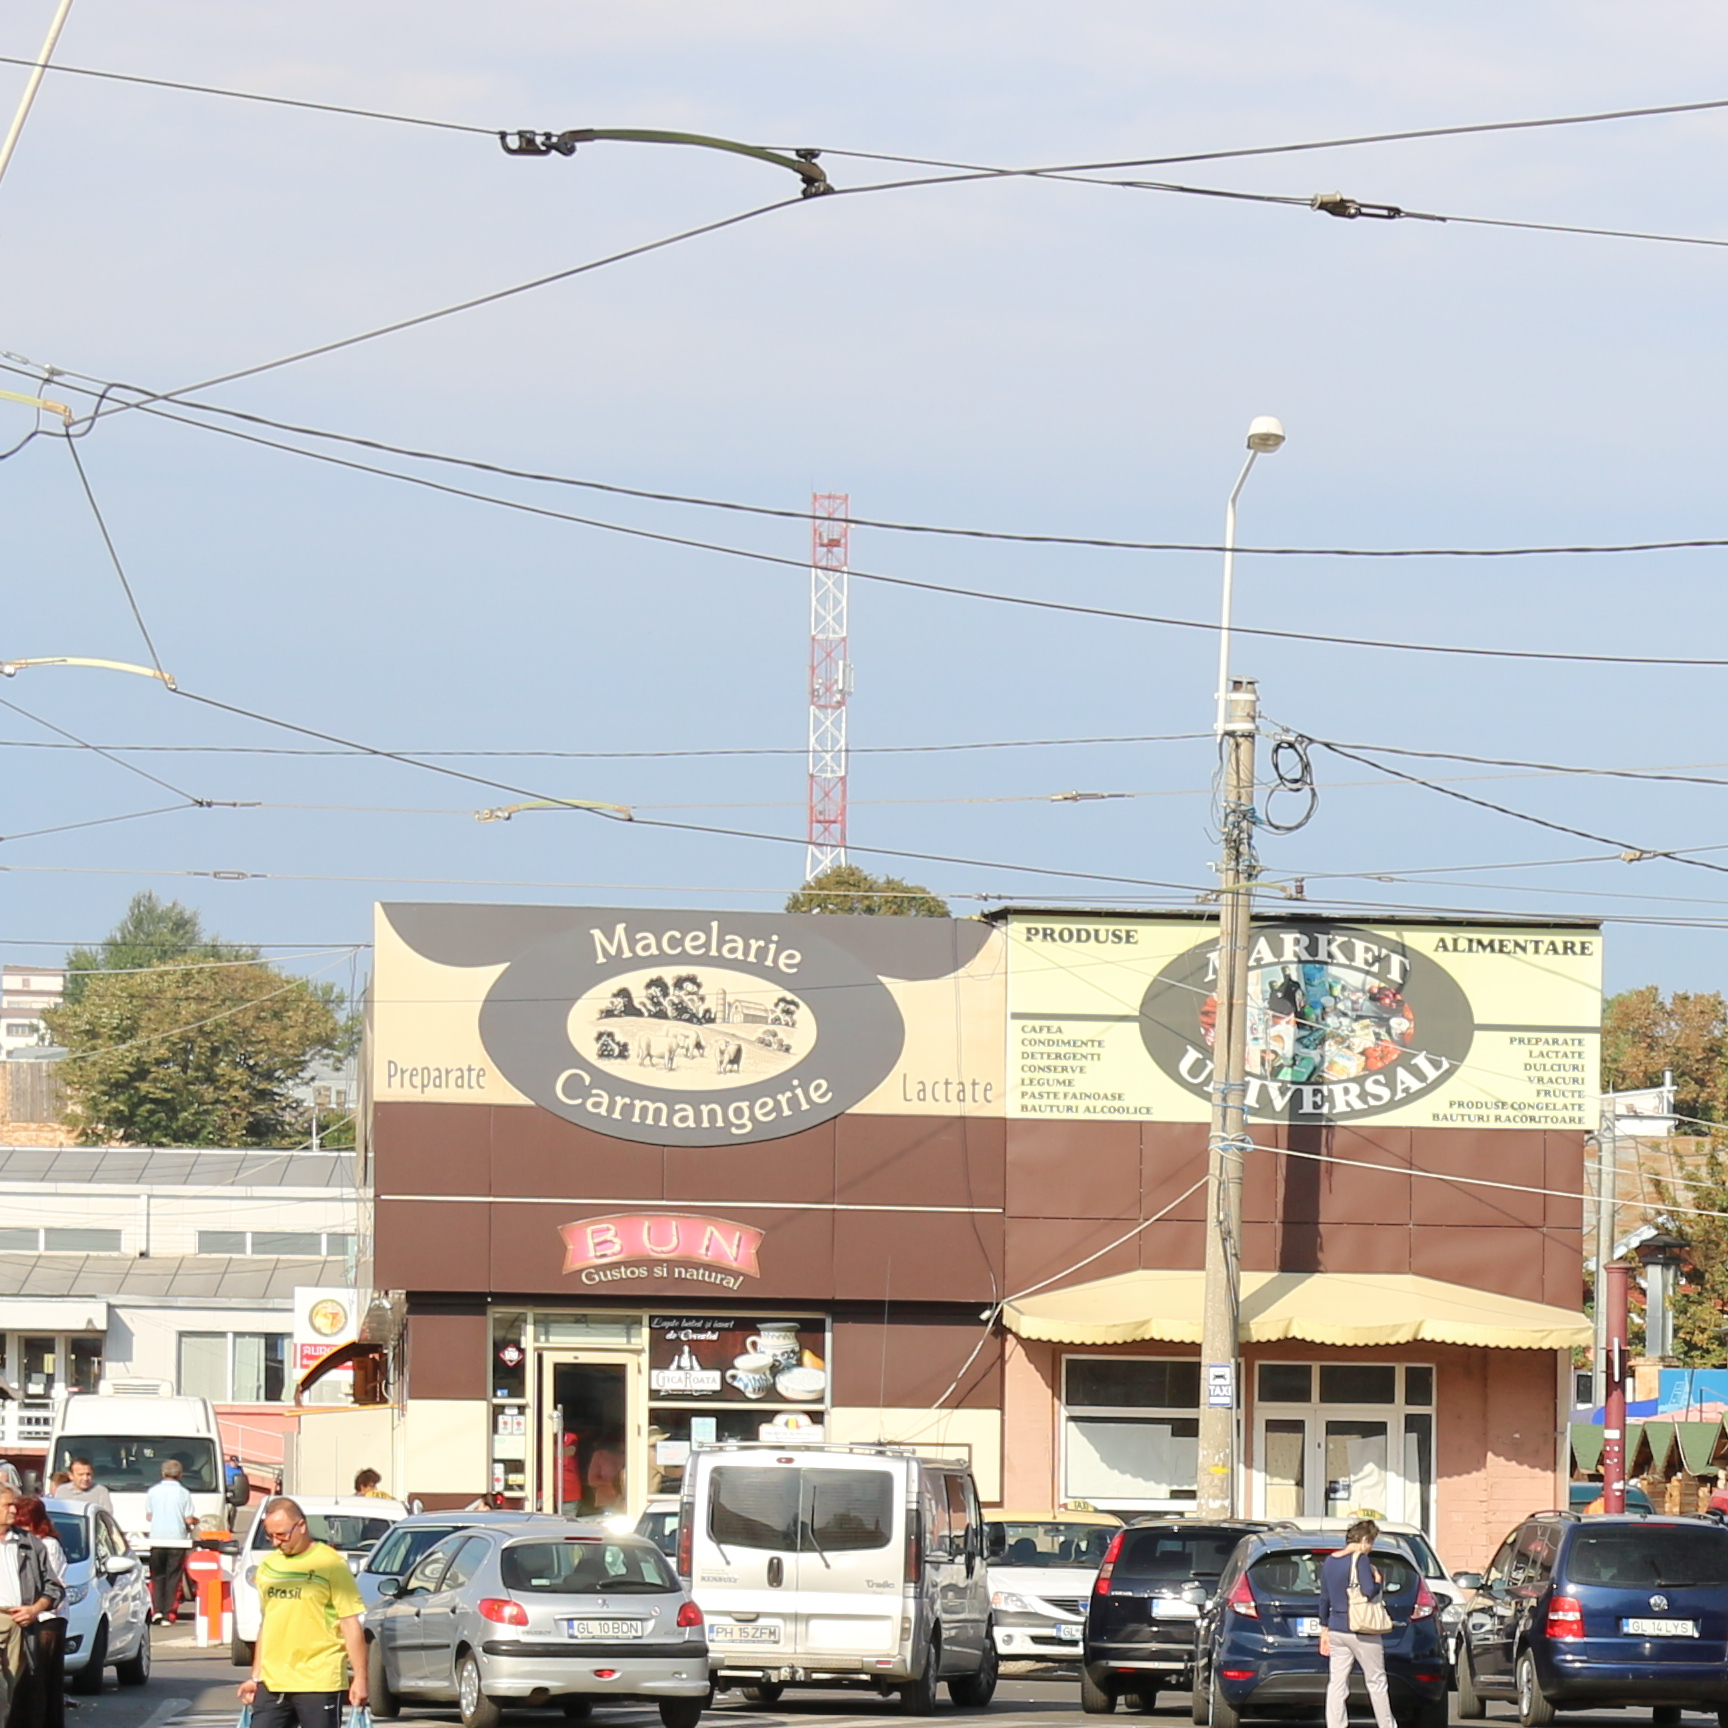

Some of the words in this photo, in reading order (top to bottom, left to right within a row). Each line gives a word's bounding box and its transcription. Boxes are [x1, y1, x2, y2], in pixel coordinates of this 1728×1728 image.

[1025, 925, 1139, 946] PRODUSE
[589, 921, 803, 976] Macelarie
[1433, 936, 1594, 957] ALIMENTARE
[1020, 1024, 1063, 1034] CAFEA
[1020, 1038, 1105, 1048] CONDIMENTE
[1509, 1036, 1586, 1047] PREPARATE
[1020, 1051, 1102, 1061] DETERGENTI
[1528, 1050, 1586, 1060] LACTATE
[1020, 1064, 1087, 1074] CONSERVE
[1523, 1062, 1586, 1072] DULCIURI
[386, 1059, 488, 1094] Preparate
[1020, 1077, 1075, 1087] LEGUME
[1177, 1045, 1452, 1115] UIVERSAL
[1527, 1076, 1586, 1086] VRACURI
[902, 1072, 994, 1104] Lactate
[1536, 1089, 1586, 1099] FRUCTE
[554, 1067, 834, 1135] Carmangerie
[1020, 1090, 1060, 1100] PASTE
[1063, 1092, 1125, 1101] FAINOASE
[1020, 1103, 1079, 1114] BAUTURI
[1083, 1105, 1154, 1115] ALCOOLICE
[1448, 1100, 1508, 1111] PRODUSE
[1510, 1101, 1586, 1112] CONGELATE
[1432, 1112, 1490, 1123] BAUTURI
[1494, 1114, 1586, 1125] RACORITOARE
[586, 1219, 743, 1263] BUN
[581, 1262, 649, 1287] Gustos
[653, 1262, 669, 1280] si
[673, 1265, 745, 1292] natural
[684, 1371, 717, 1388] ROATA
[1209, 1385, 1231, 1397] TAXI
[1073, 1501, 1090, 1509] TAXI
[1362, 1509, 1377, 1518] TAXI
[267, 1587, 302, 1601] Brasil
[577, 1622, 593, 1635] GL
[598, 1622, 610, 1634] 10
[612, 1622, 639, 1635] BDN
[716, 1627, 733, 1637] PH
[738, 1627, 750, 1638] 15
[751, 1628, 777, 1639] ZFM
[1632, 1622, 1647, 1633] GL
[1651, 1622, 1664, 1633] 14
[1665, 1621, 1689, 1633] LYS
[1062, 1628, 1077, 1639] GL
